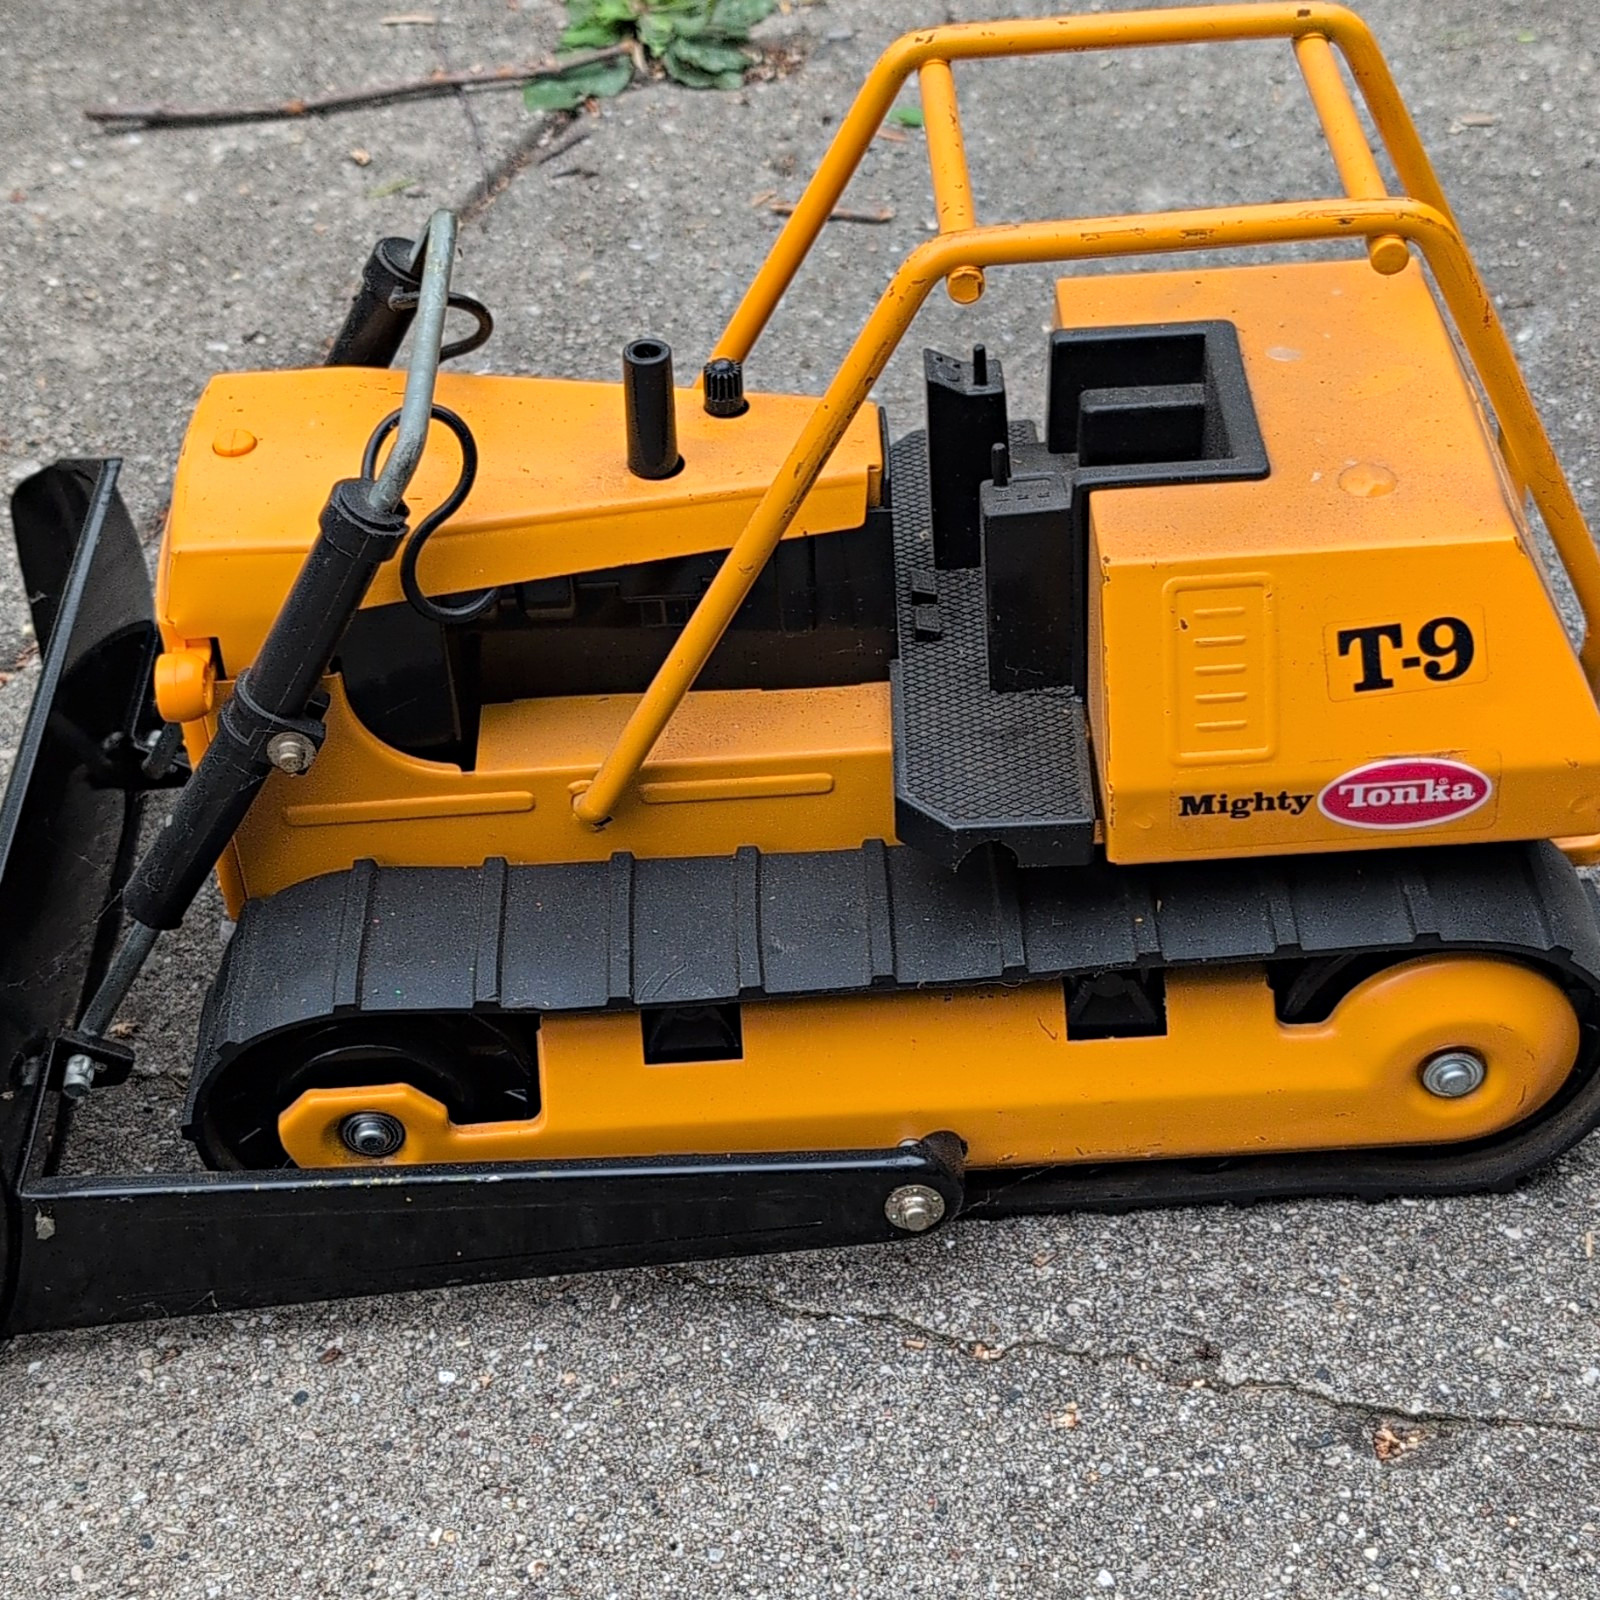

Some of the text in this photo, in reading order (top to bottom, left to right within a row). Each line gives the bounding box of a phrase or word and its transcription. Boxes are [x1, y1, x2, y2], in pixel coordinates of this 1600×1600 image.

[1337, 616, 1475, 693] T-9
[1178, 778, 1476, 819] Mighty Tonka
